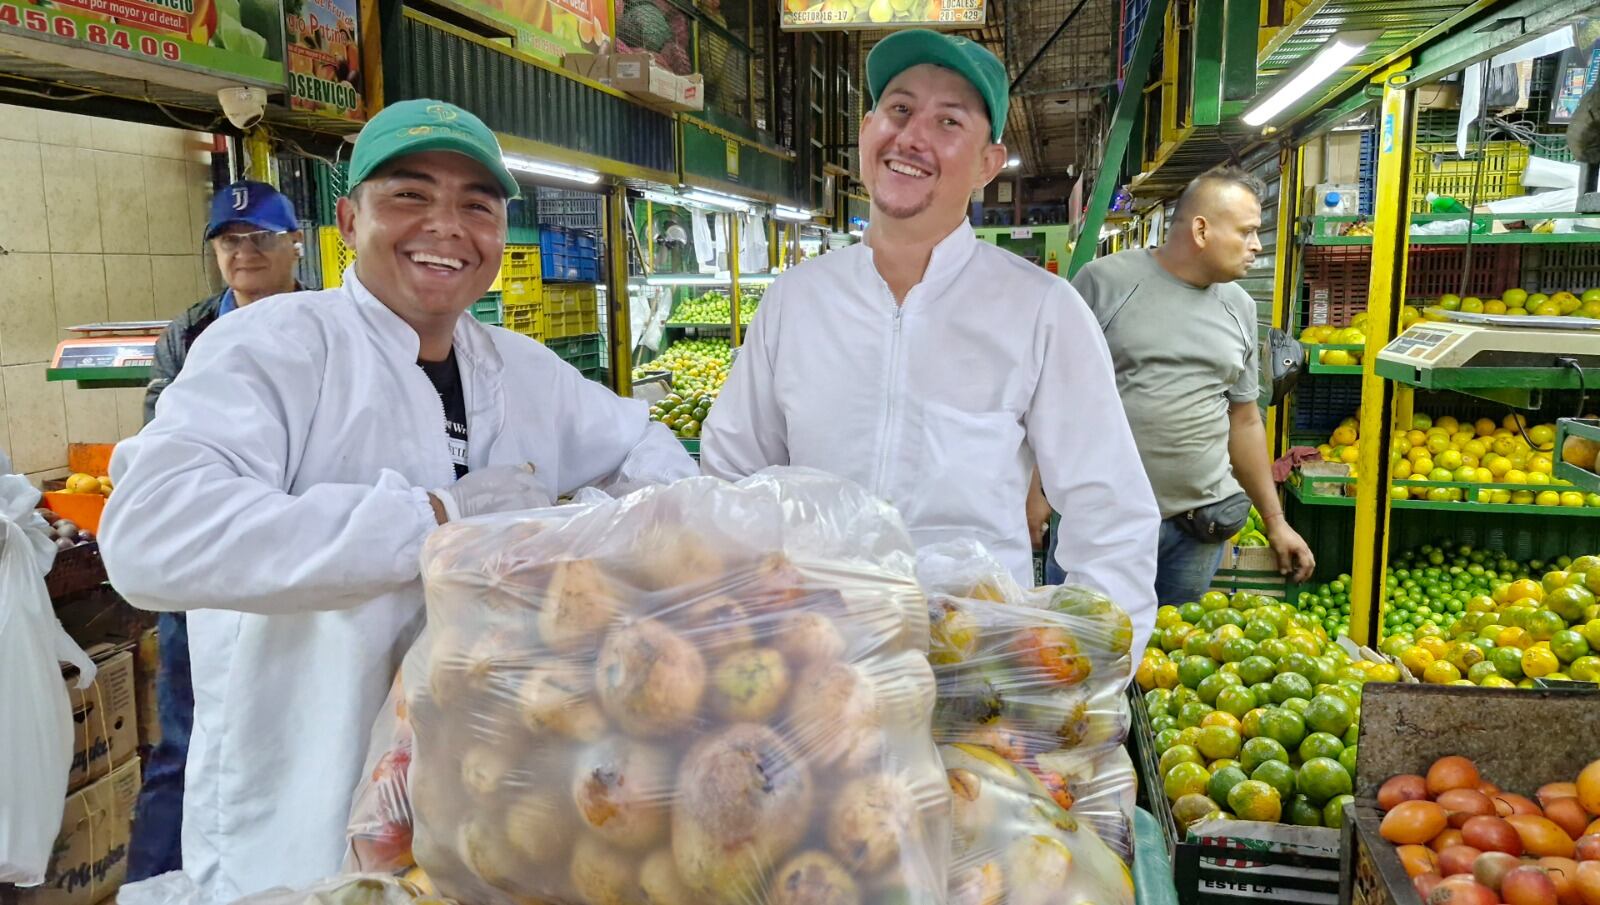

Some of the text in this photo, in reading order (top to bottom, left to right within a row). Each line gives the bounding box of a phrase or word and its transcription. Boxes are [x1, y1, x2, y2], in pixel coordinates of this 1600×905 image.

[110, 2, 139, 18] mayor
[142, 10, 148, 21] y
[149, 11, 157, 22] al
[793, 11, 820, 21] SECTOR
[1205, 880, 1247, 891] ESTE
